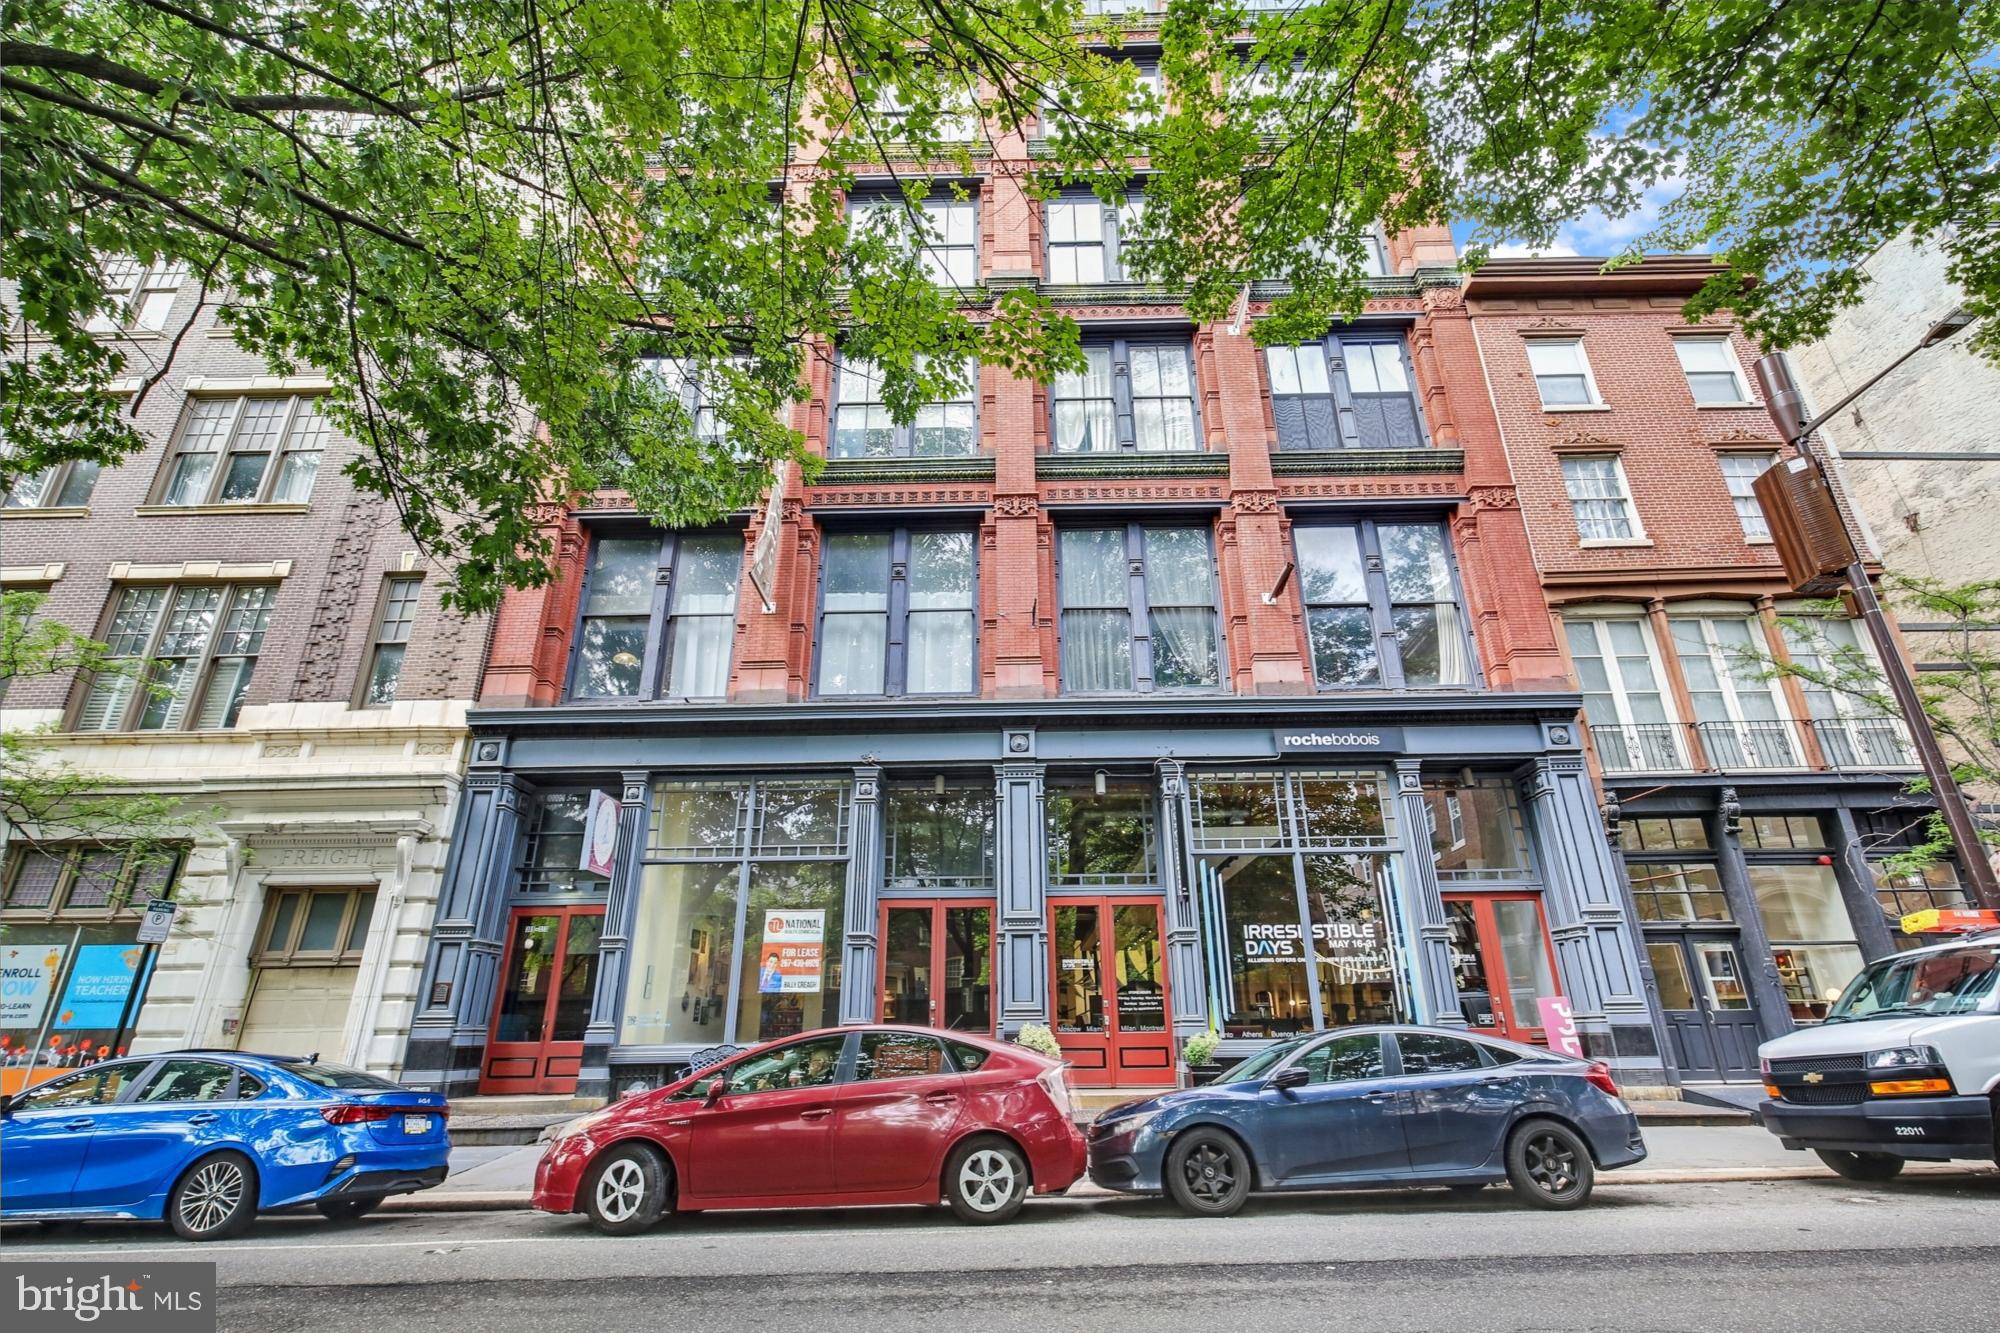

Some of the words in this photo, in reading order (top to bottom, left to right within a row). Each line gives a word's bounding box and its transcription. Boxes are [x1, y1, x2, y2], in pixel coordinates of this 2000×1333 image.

[1284, 733, 1379, 746] rochebobois
[281, 848, 376, 864] FREIGHT
[785, 919, 821, 929] NATIONAL
[1243, 924, 1375, 939] IRRESISTIBLE
[1245, 940, 1293, 956] DAYS
[1329, 940, 1350, 949] MAY
[1353, 940, 1377, 949] 16-31
[797, 948, 820, 957] LEASE
[78, 975, 101, 983] NOW
[103, 975, 132, 983] HIRIN
[1, 980, 38, 996] OW
[75, 985, 129, 996] TEACHER
[1895, 1127, 1925, 1135] 22011
